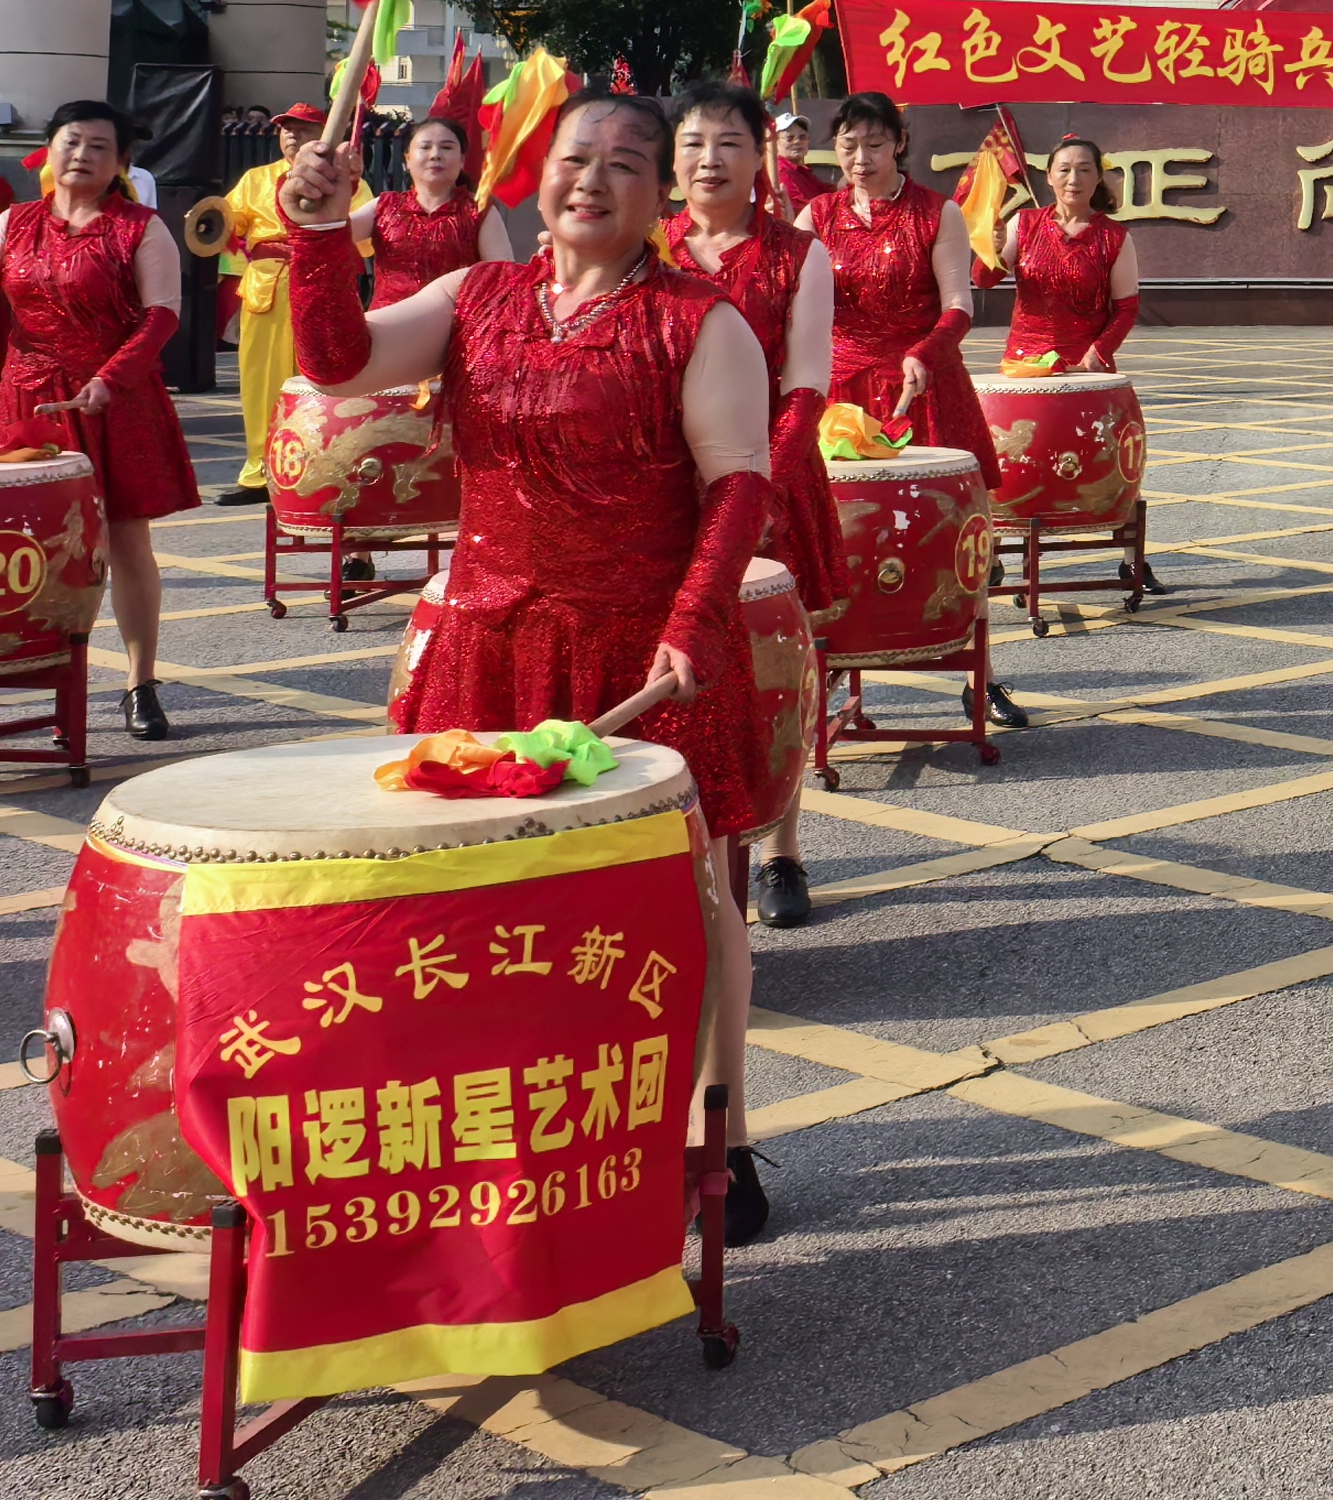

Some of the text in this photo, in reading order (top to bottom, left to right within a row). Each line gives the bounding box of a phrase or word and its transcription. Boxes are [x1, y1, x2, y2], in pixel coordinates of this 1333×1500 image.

[272, 440, 303, 477] 18
[962, 533, 991, 578] 19
[219, 923, 678, 1079] 武汉长江新区
[225, 1034, 670, 1198] 阳逻新星艺术团
[265, 1146, 643, 1258] 15392926163
